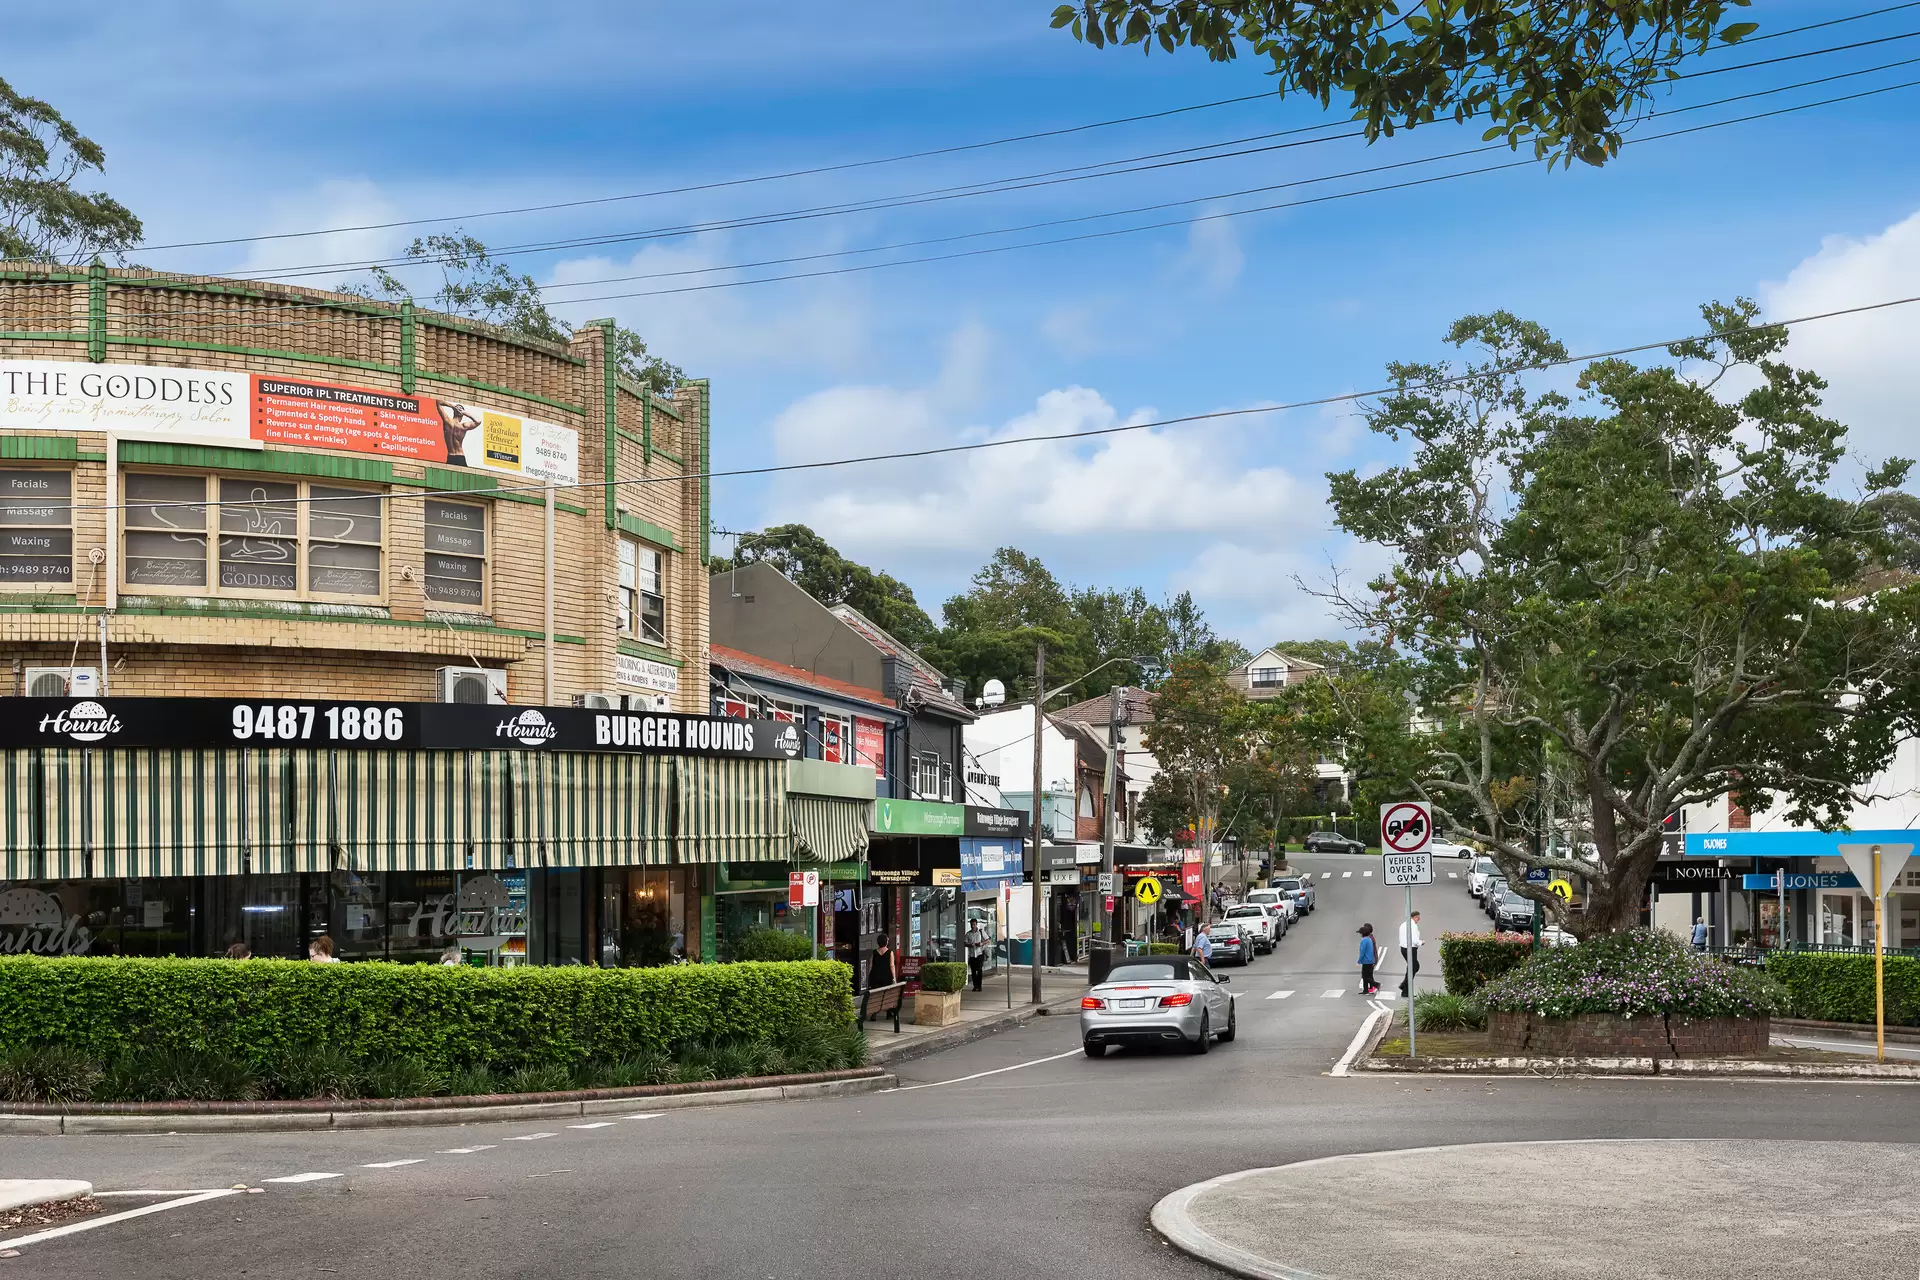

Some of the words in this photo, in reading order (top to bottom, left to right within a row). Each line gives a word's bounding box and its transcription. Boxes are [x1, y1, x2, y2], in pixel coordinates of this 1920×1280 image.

[3, 371, 67, 396] THE
[80, 374, 233, 406] GODDESS
[263, 382, 313, 397] SUPERIOR
[316, 388, 331, 399] IPL
[334, 391, 394, 408] TREATMENTS
[396, 400, 417, 411] FOR:
[266, 397, 308, 408] Permanent
[310, 402, 327, 411] Hair
[329, 404, 363, 415] reduction
[2, 398, 54, 424] Beauty
[58, 399, 86, 415] and
[89, 398, 183, 428] Aromatherapy
[191, 406, 231, 423] Salon
[266, 408, 308, 420] Pigmented
[310, 412, 317, 420] &
[318, 413, 342, 425] Spotty
[344, 417, 366, 427] hands
[380, 411, 395, 420] Skin
[397, 414, 438, 427] rejuvenation
[266, 418, 297, 429] Reverse
[314, 423, 344, 435] damage
[345, 427, 361, 437] (age
[363, 430, 382, 440] spots
[384, 432, 390, 440] &
[391, 434, 436, 447] pigmentation
[380, 422, 397, 431] Acne
[266, 429, 281, 438] fine
[283, 432, 303, 441] lines
[304, 433, 311, 441] &
[313, 435, 348, 446] wrinkles)
[381, 441, 418, 454] Capillaries
[541, 439, 561, 450] Phone:
[535, 447, 551, 458] 9489
[552, 451, 568, 462] 8740
[543, 460, 559, 471] Web:
[11, 479, 48, 489] Facials
[6, 506, 54, 518] Massage
[440, 509, 468, 521] Facials
[11, 536, 51, 548] Waxing
[437, 534, 472, 546] Massage
[0, 564, 9, 575] h:
[11, 565, 39, 575] 9489
[42, 565, 70, 575] 8740
[438, 560, 467, 573] Waxing
[222, 573, 294, 588] GODDESS
[424, 584, 437, 594] Ph:
[438, 586, 459, 596] 9489
[460, 588, 480, 598] 8740
[39, 709, 124, 735] Hounds
[232, 705, 315, 740] 9487
[324, 706, 404, 741] 1886
[496, 716, 558, 740] Hounds
[595, 715, 681, 748] BURGER
[686, 719, 754, 752] HOUNDS
[774, 732, 801, 751] Hounds
[967, 772, 986, 784] AVENUE
[1388, 856, 1425, 865] VEHICLES
[824, 867, 857, 876] Pharmacy
[1390, 865, 1413, 874] OVER
[1416, 865, 1425, 874] 3t
[1675, 868, 1731, 878] NOVELLA
[1397, 874, 1418, 882] GVM
[1770, 875, 1838, 888] DJONES
